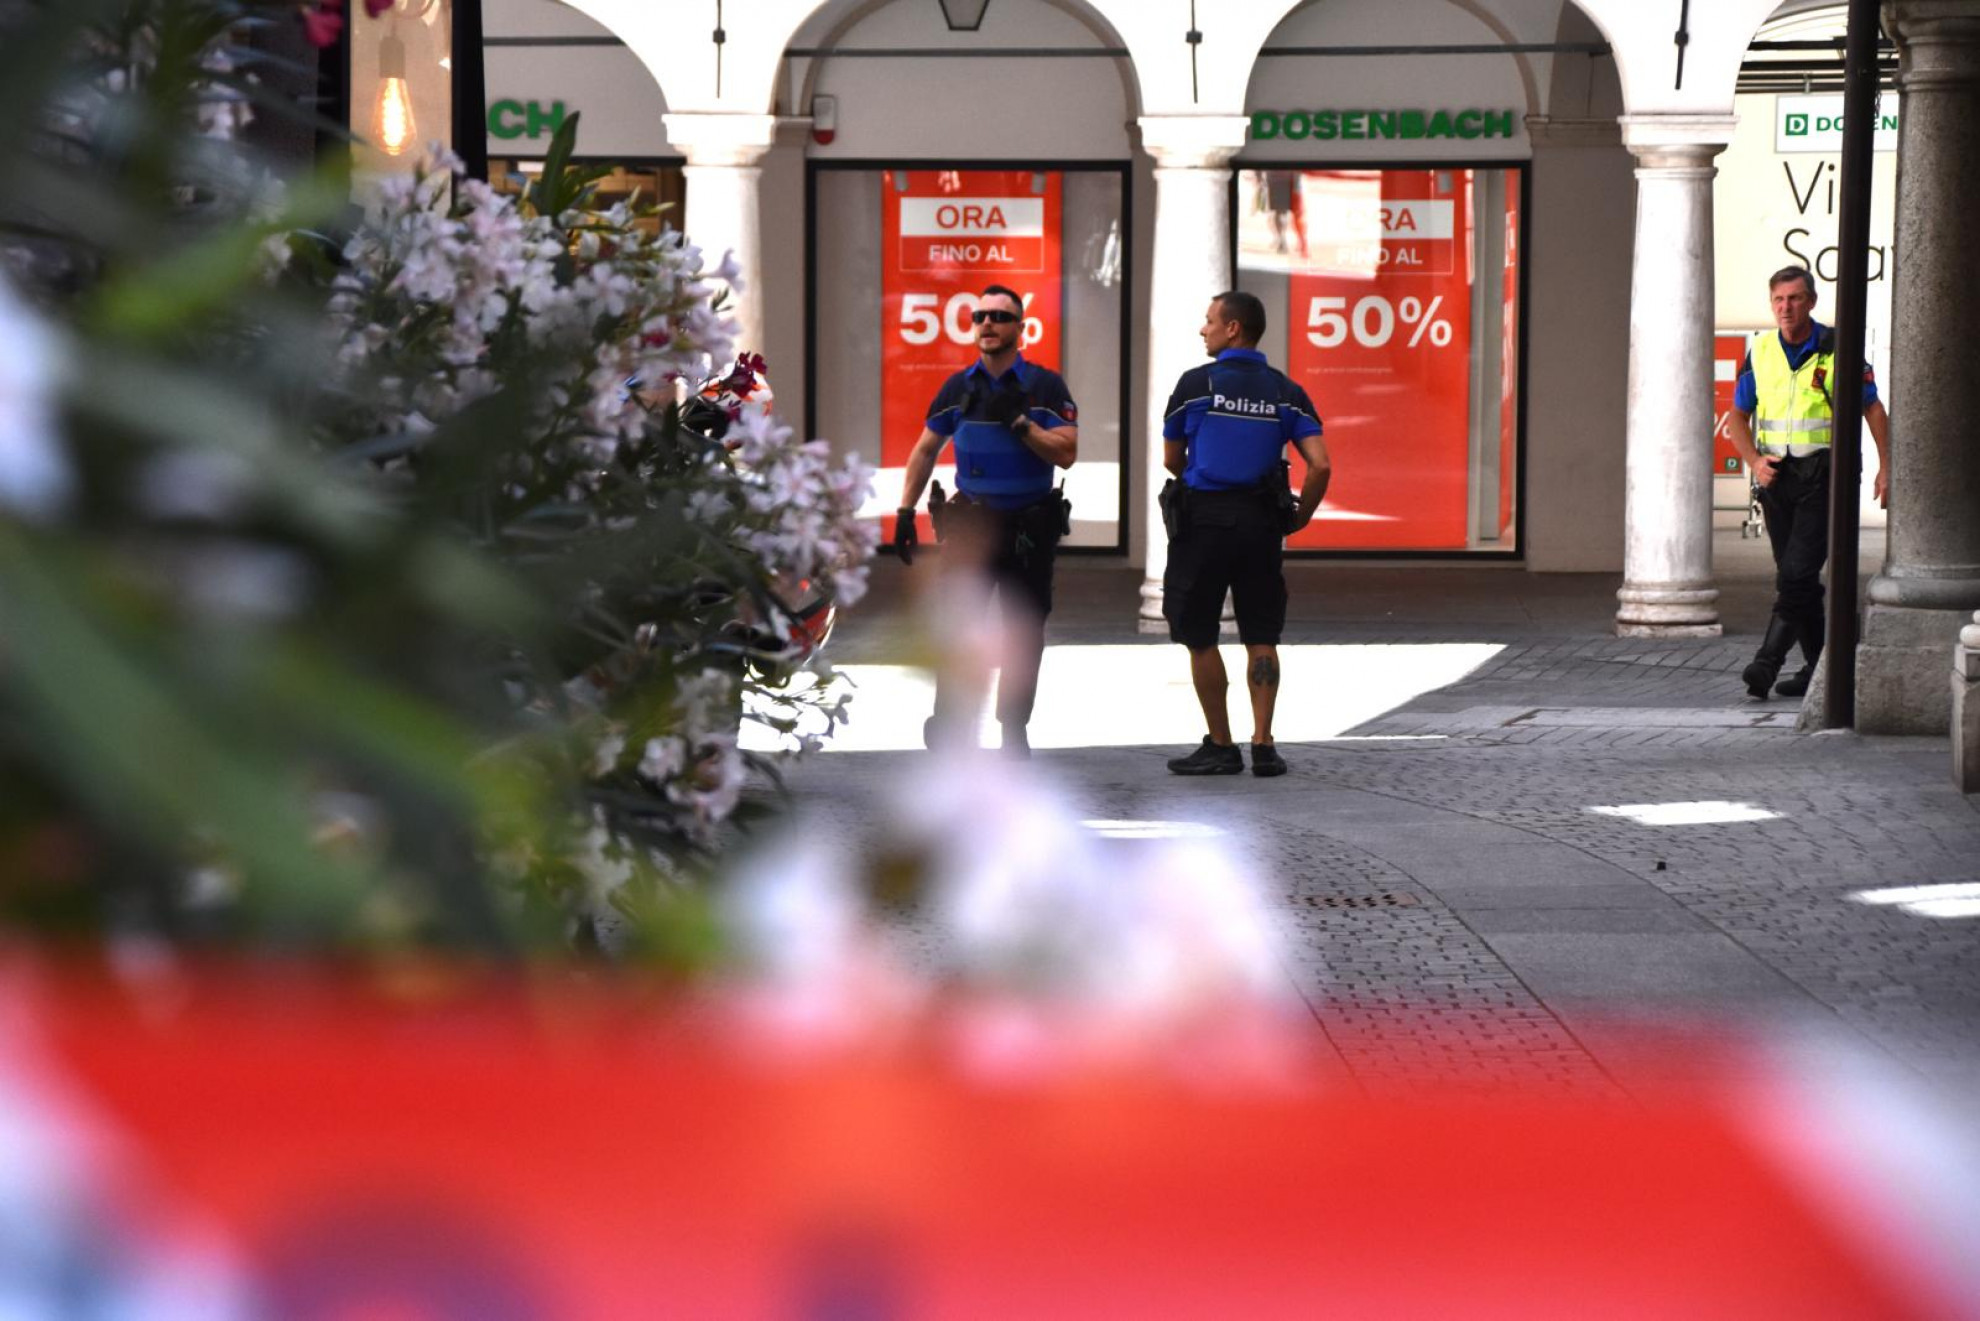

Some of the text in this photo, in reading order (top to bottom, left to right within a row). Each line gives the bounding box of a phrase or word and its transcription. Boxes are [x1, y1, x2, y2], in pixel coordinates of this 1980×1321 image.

[1251, 110, 1513, 140] DOSENBACH
[936, 205, 1007, 229] ORA
[929, 245, 1014, 262] FINO AL
[1395, 248, 1423, 264] AL
[1307, 295, 1453, 348] 50%
[1214, 394, 1277, 415] Polizia
